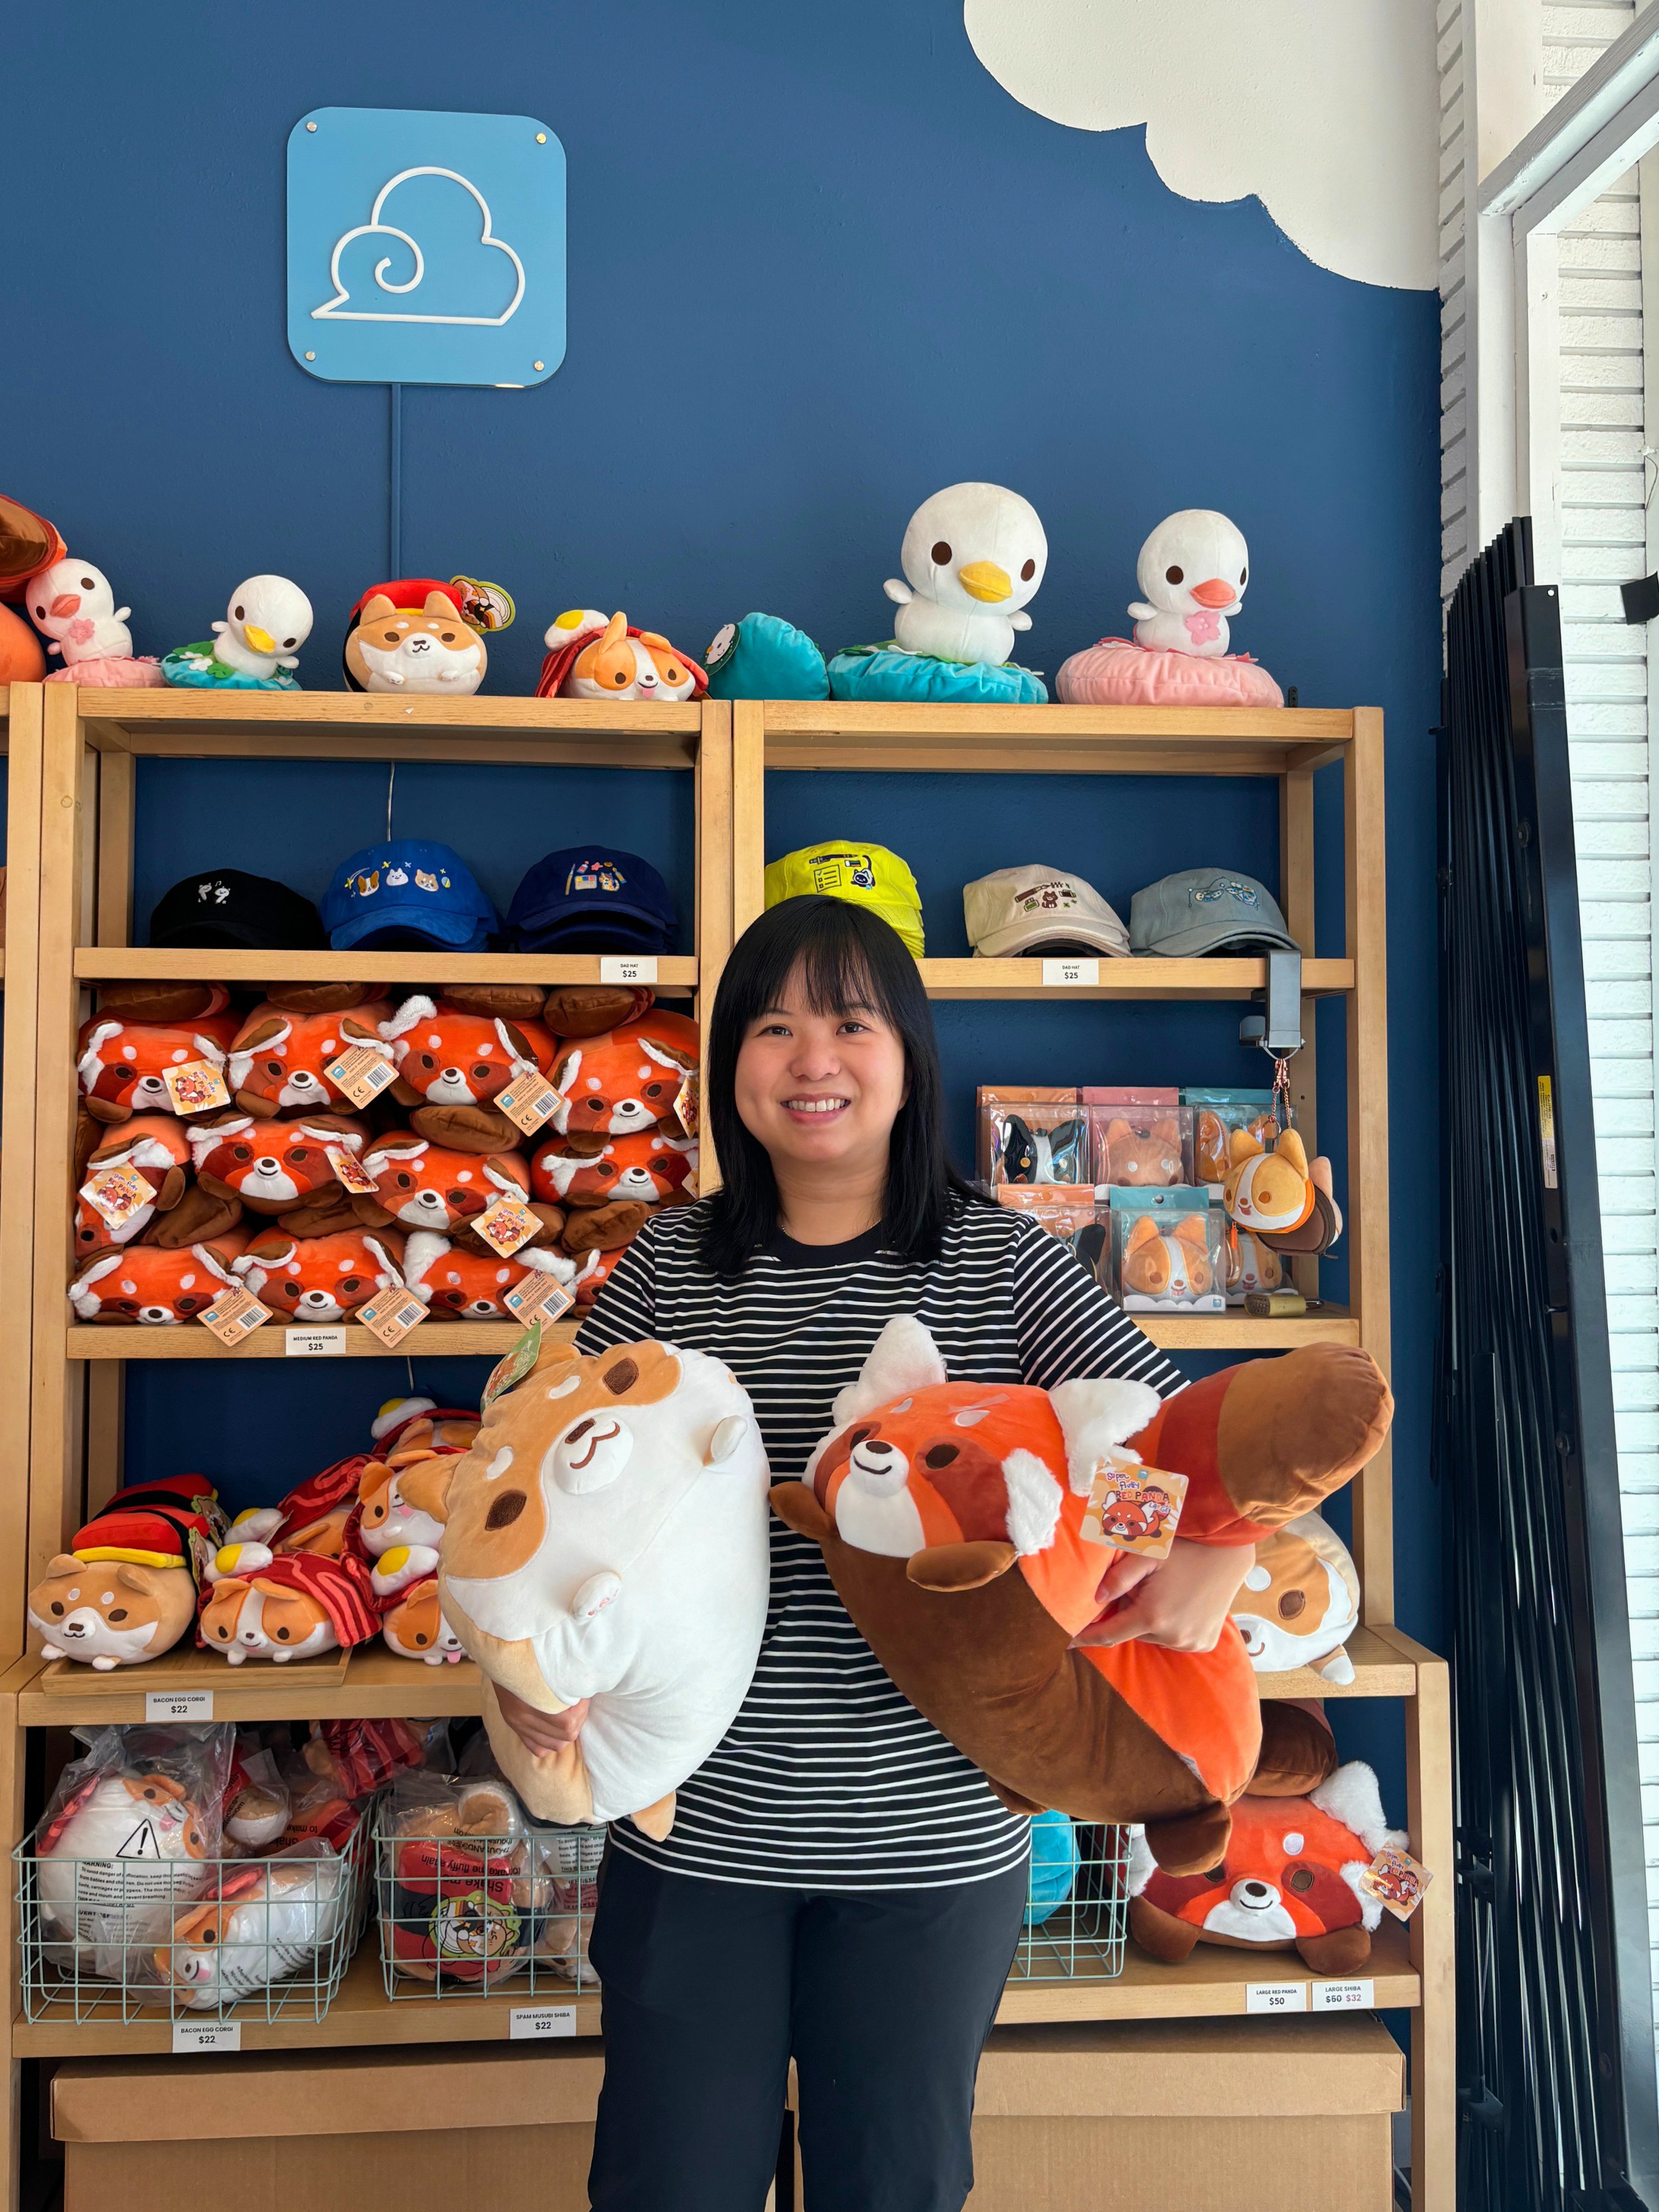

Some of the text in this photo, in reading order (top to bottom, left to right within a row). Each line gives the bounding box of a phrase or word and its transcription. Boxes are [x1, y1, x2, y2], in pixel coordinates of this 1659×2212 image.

[1116, 1490, 1169, 1501] RED PANDA
[447, 1860, 470, 1873] fluffy
[1269, 1997, 1285, 2006] $50
[1346, 1994, 1362, 2002] $32
[535, 2021, 551, 2030] $22
[198, 2036, 216, 2044] $22
